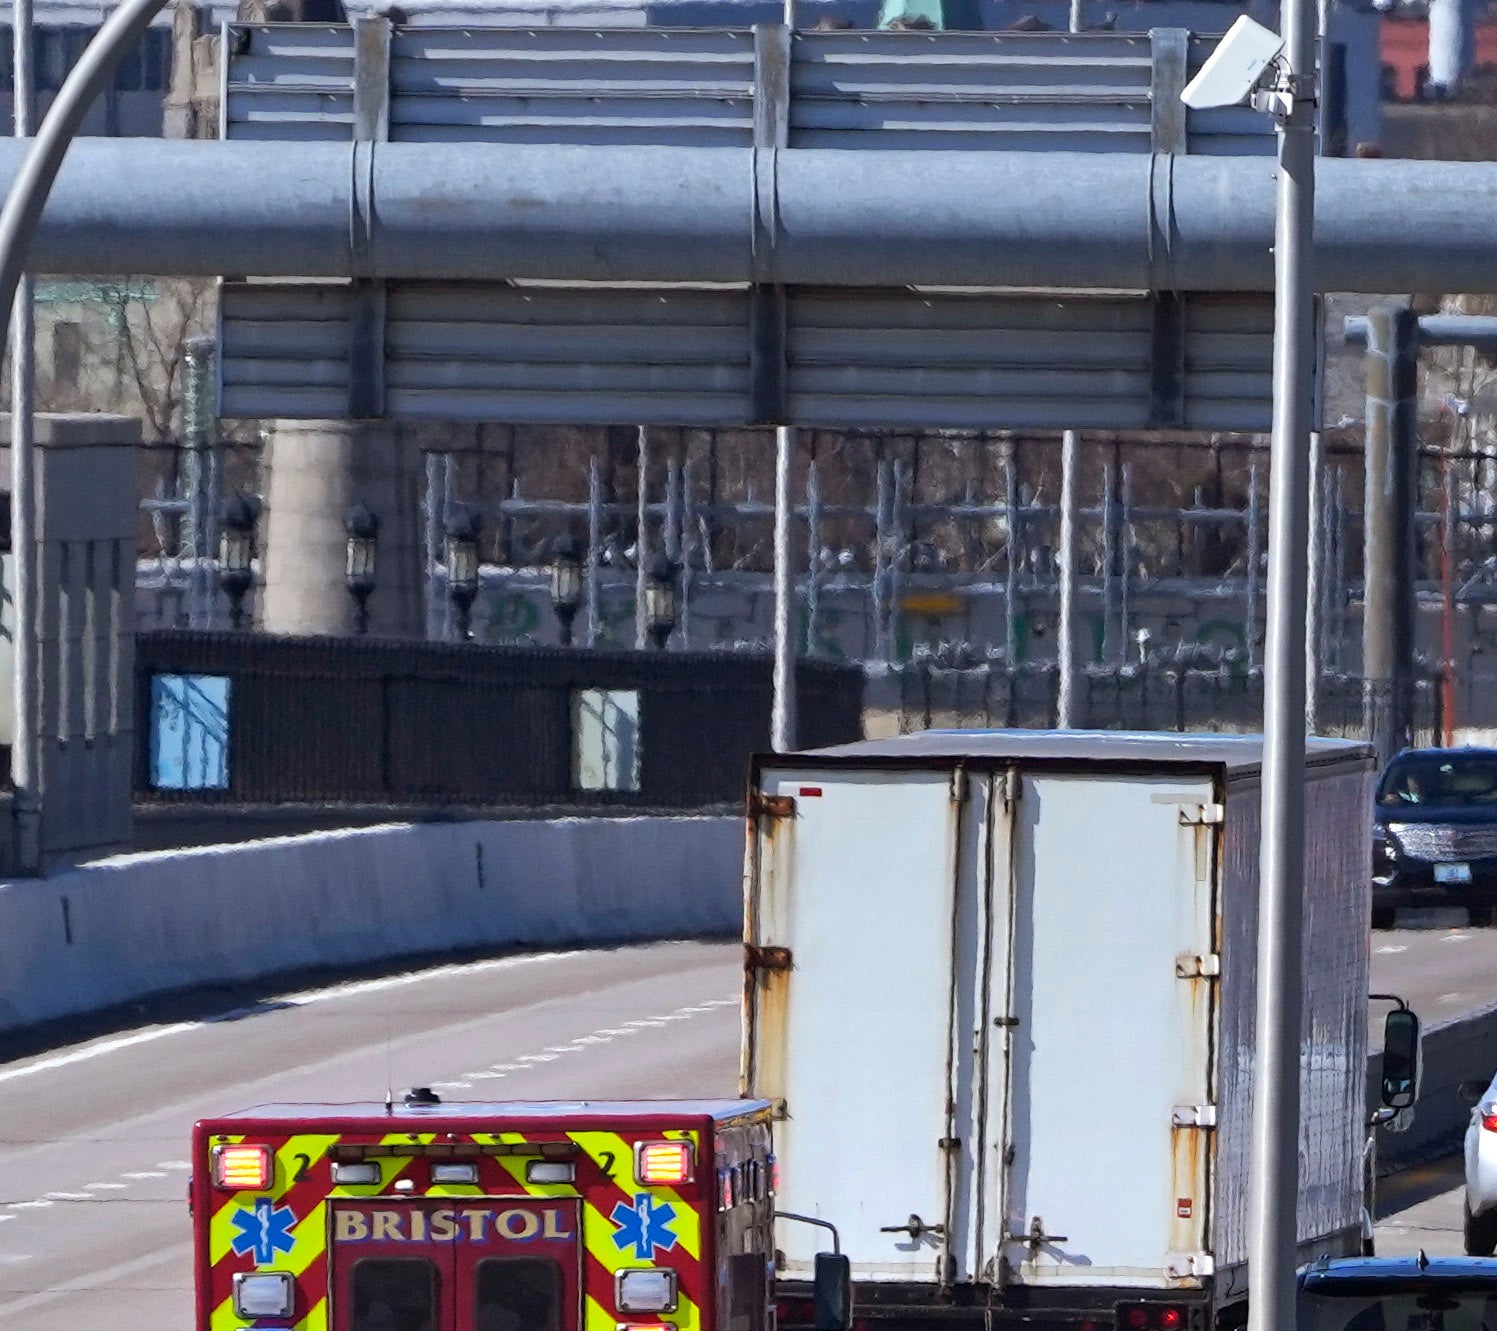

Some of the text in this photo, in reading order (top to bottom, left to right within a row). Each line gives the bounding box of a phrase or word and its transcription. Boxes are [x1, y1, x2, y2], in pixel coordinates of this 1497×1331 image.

[292, 1153, 311, 1182] 2
[598, 1151, 617, 1179] 2
[334, 1209, 572, 1243] BRISTOL
